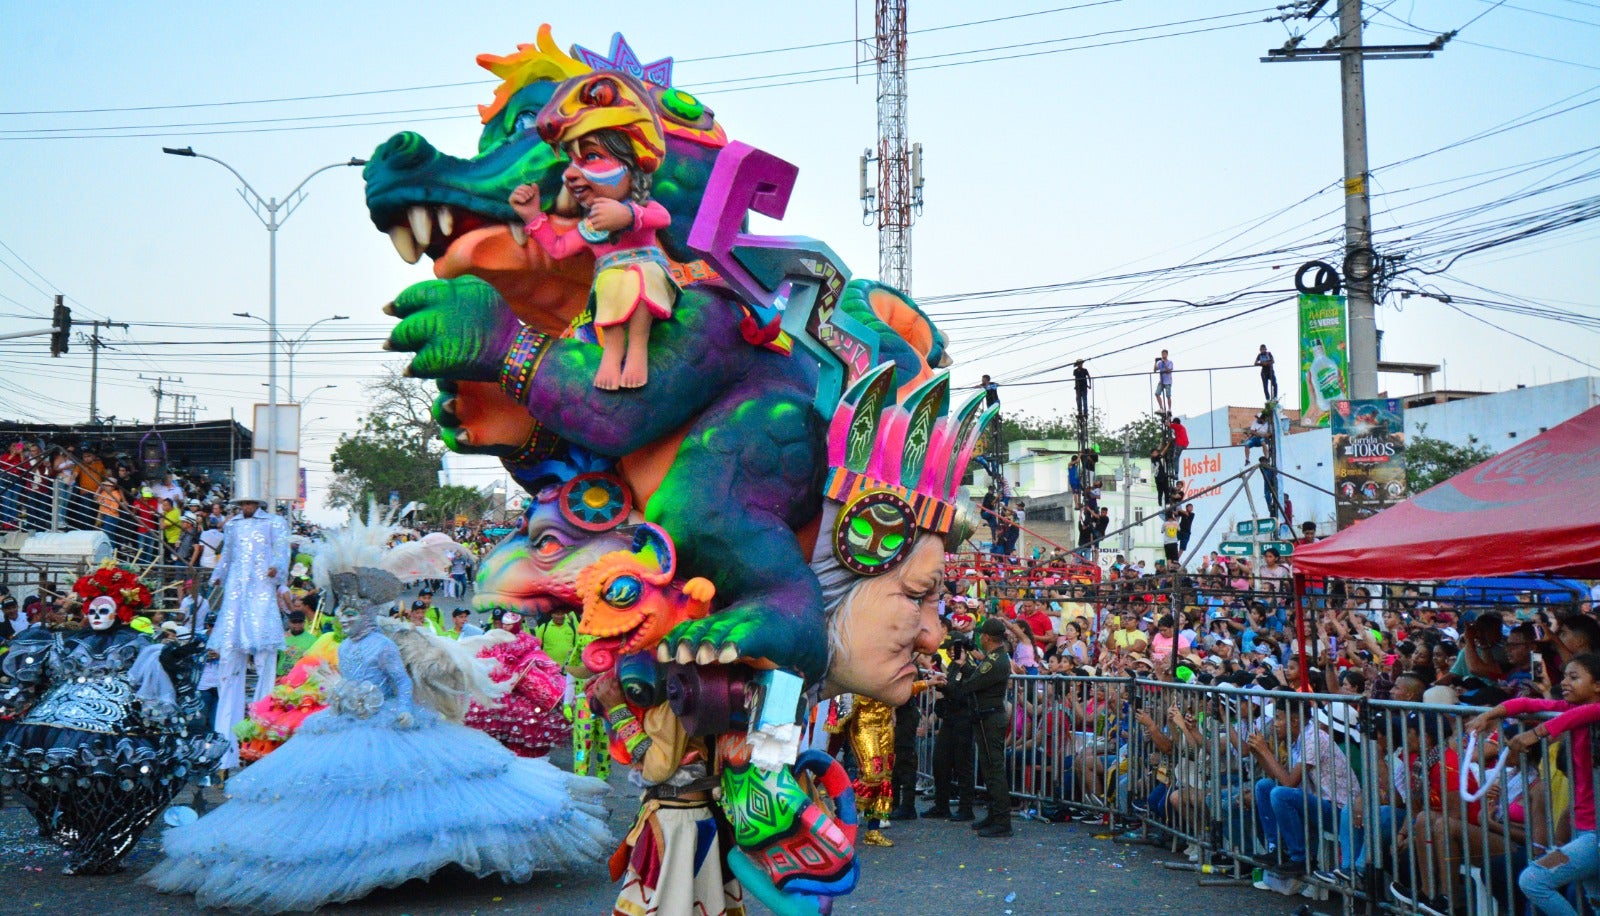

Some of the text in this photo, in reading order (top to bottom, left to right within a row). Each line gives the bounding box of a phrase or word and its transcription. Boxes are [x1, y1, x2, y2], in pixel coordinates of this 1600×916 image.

[1349, 434, 1378, 444] Corrida
[1351, 442, 1396, 457] TOROS
[1183, 452, 1222, 478] Hostal
